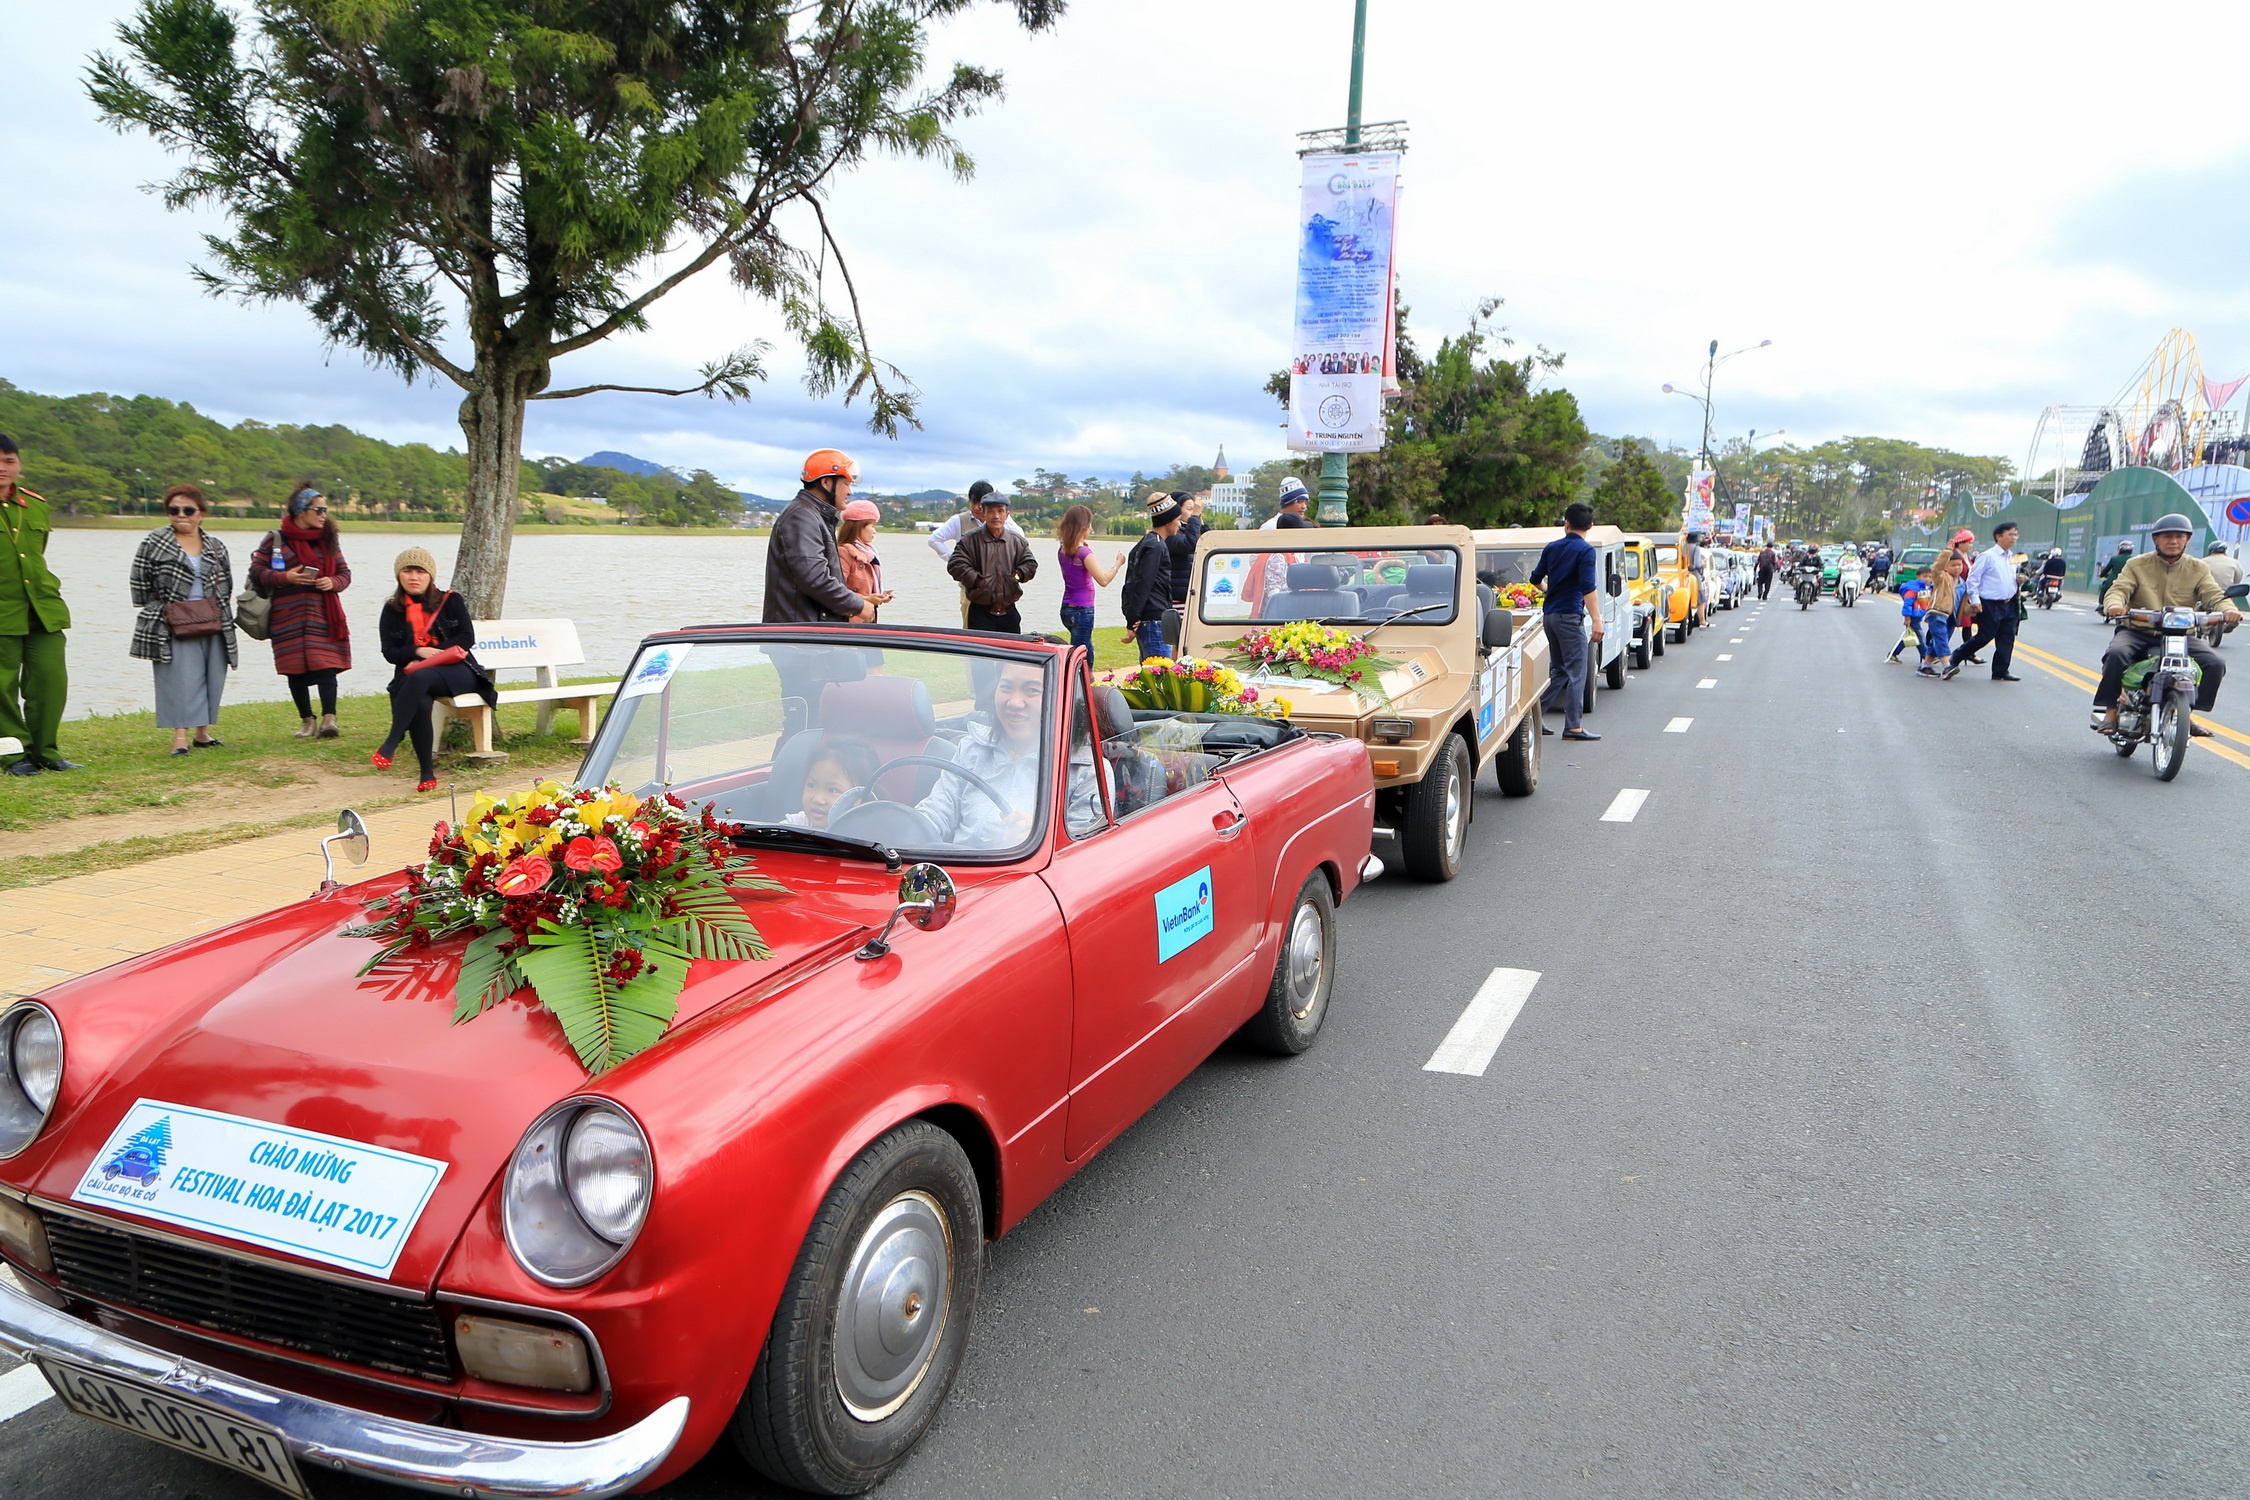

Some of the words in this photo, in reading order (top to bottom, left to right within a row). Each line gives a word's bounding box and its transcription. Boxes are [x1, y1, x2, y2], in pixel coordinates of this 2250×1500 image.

[1338, 431, 1363, 439] NGUYÊN
[249, 1140, 300, 1175] CHÀO
[293, 1150, 356, 1185] MỪNG
[130, 1189, 143, 1198] XE
[170, 1166, 243, 1205] FESTIVAL
[244, 1184, 290, 1217] HOA
[283, 1189, 316, 1221] ĐÀ
[313, 1202, 349, 1234] LẠT
[344, 1207, 398, 1241] 2017
[58, 1368, 288, 1484] 49A-001.81
